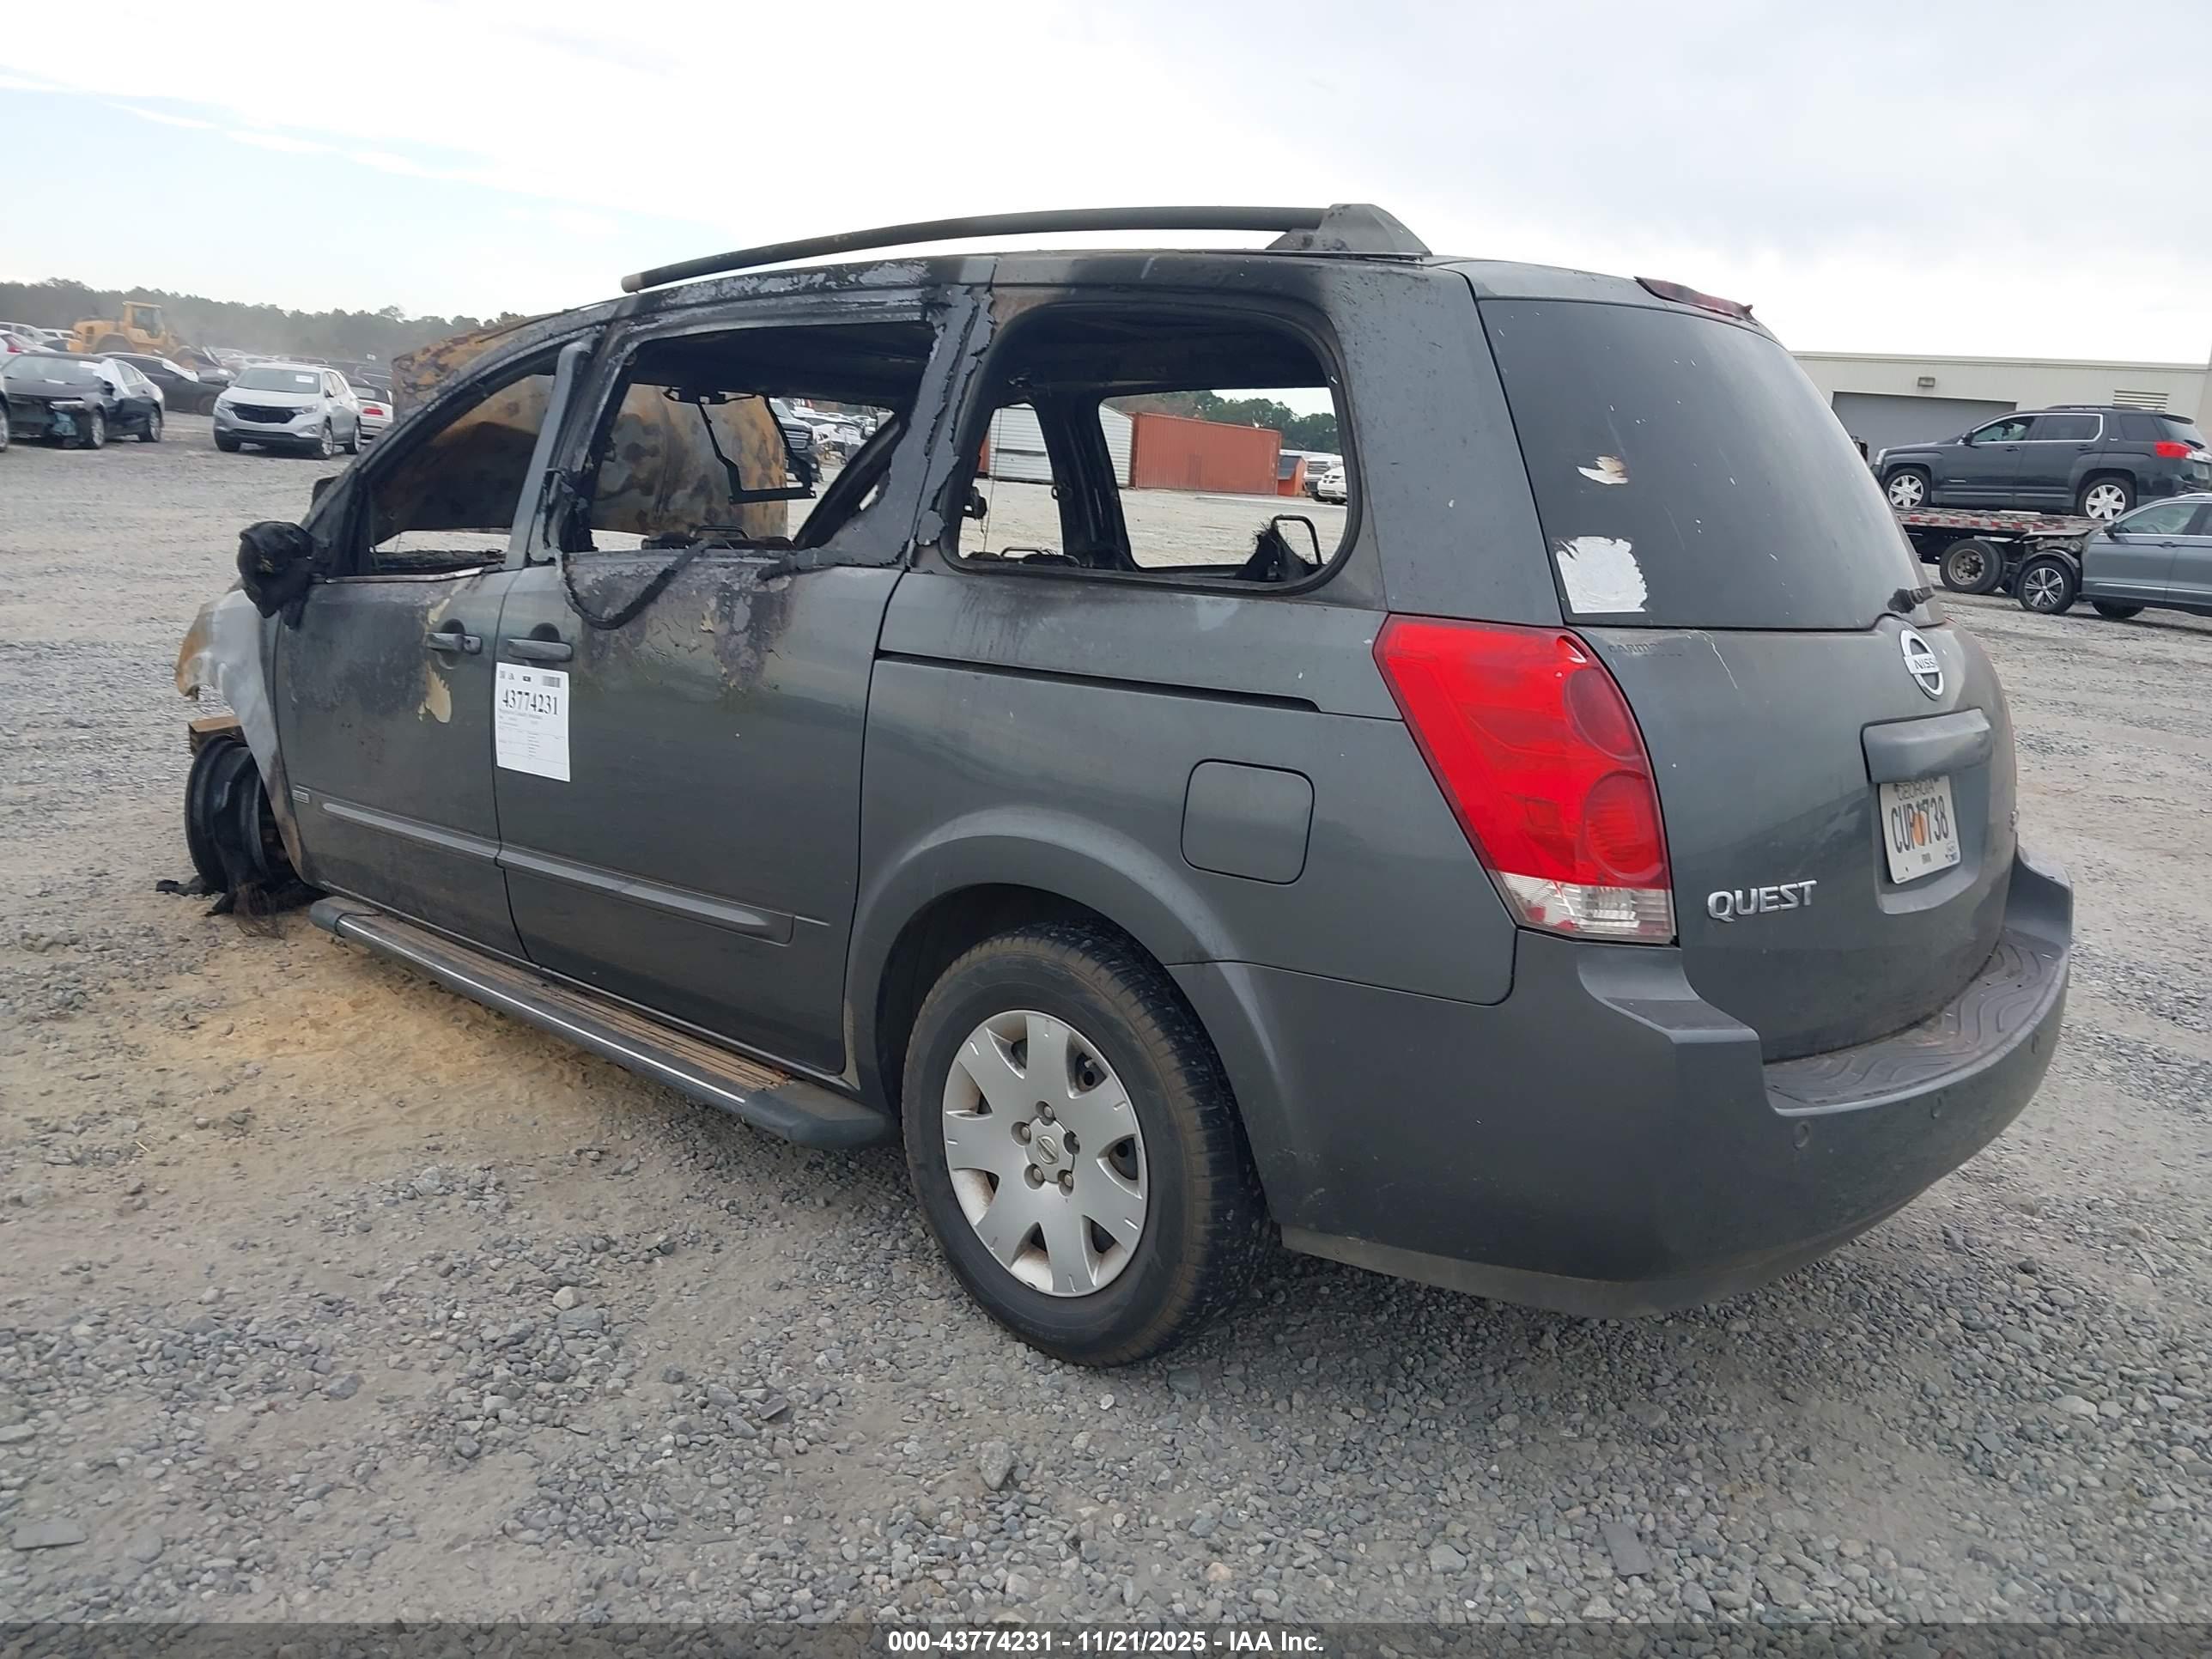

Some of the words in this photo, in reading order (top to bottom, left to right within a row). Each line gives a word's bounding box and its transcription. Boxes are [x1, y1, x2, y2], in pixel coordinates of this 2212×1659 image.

[1913, 658, 1938, 670] NISS
[501, 689, 558, 715] 43774231
[1707, 879, 1818, 923] QUEST
